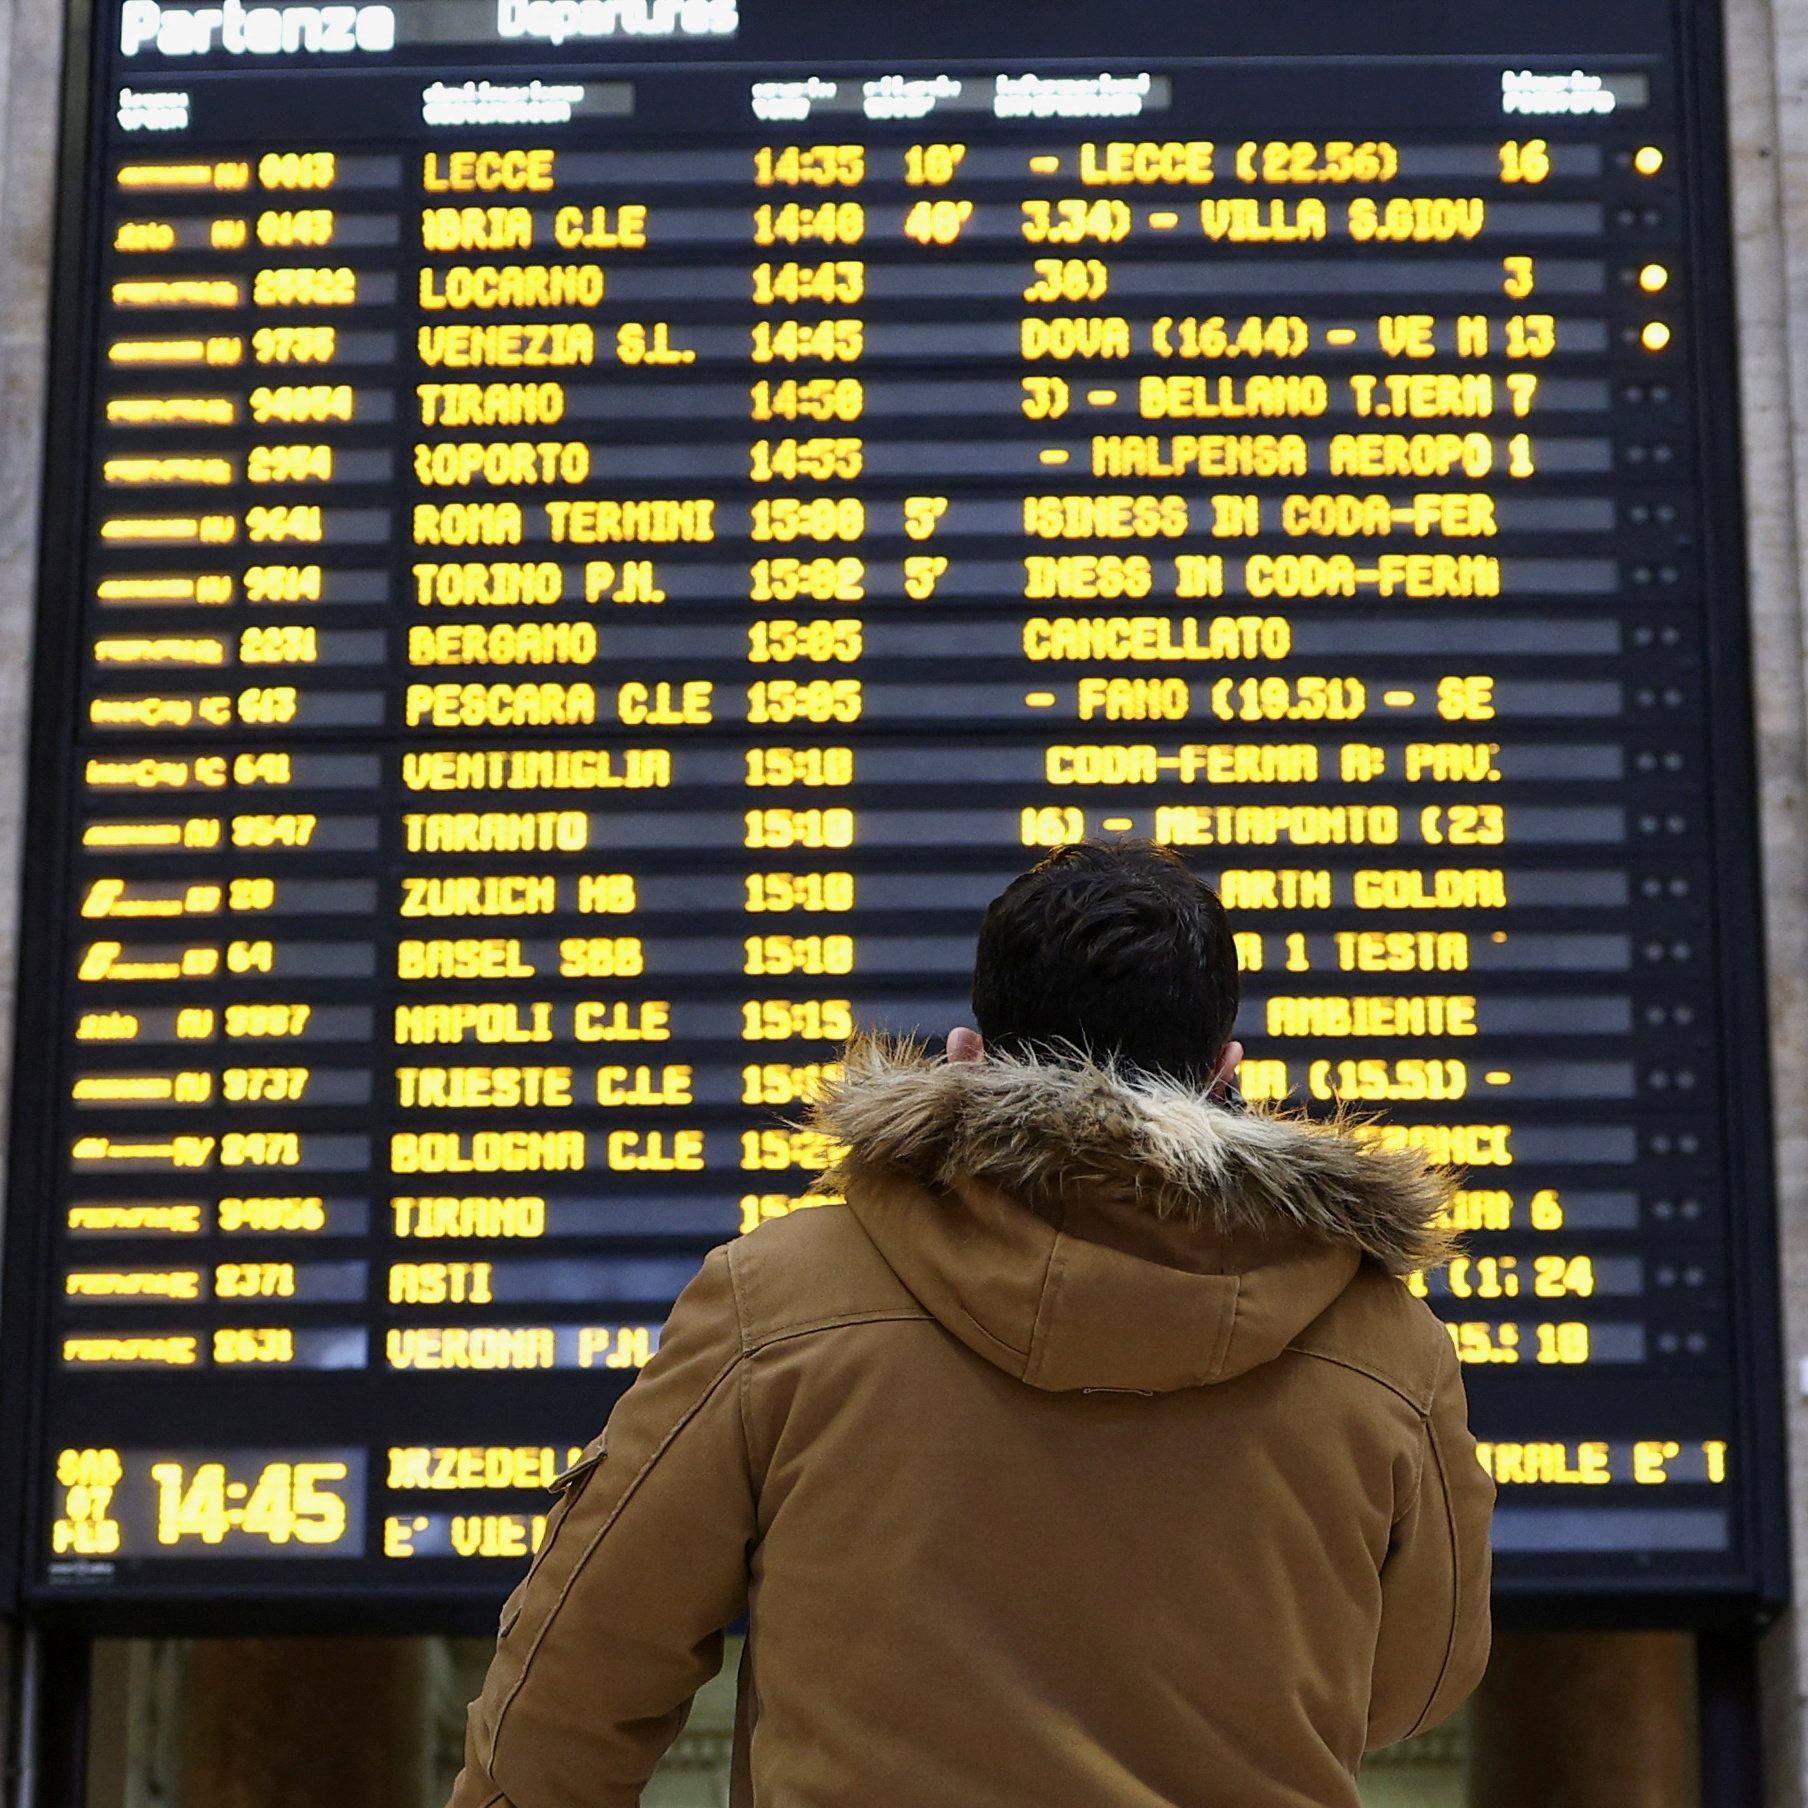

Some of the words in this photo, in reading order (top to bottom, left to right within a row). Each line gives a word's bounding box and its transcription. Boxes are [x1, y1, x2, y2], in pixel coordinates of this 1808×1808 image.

[424, 150, 554, 190] LECCE
[755, 146, 864, 184] 14:35
[1080, 142, 1213, 184] LECCE
[1237, 142, 1397, 181] (22.56)
[1499, 140, 1549, 182] 16
[754, 203, 864, 243] 14:40
[1201, 199, 1326, 240] VILLA
[1349, 198, 1484, 240] S.GIOV
[420, 265, 603, 308] LOCARNO
[753, 262, 864, 303] 14:43
[1504, 257, 1533, 297] 3
[418, 324, 593, 366] VENEZIA
[617, 323, 695, 363] S.L.
[752, 320, 863, 362] 14:45
[1021, 318, 1129, 359] DOVA
[1152, 317, 1308, 357] (16.44)
[1379, 316, 1435, 357] VE
[1506, 315, 1555, 357] 13
[417, 383, 563, 425] TIRANO
[751, 379, 863, 420] 14:50
[1140, 376, 1327, 418] BELLANO
[1351, 374, 1493, 417] T.TERM
[1507, 374, 1537, 416] 7
[751, 439, 862, 481] 14:55
[1093, 435, 1306, 476] MALPENSA
[1330, 433, 1493, 477] AEROPO
[1509, 434, 1534, 477] 1
[414, 503, 521, 544] ROMA
[546, 500, 714, 542] TERMINI
[751, 498, 864, 540] 15:00
[1212, 495, 1258, 536] IN
[1283, 494, 1497, 536] CODA-FER
[413, 563, 562, 605] TORINO
[751, 558, 864, 600] 15:02
[1175, 556, 1223, 597] IN
[409, 622, 596, 664] BERGAMO
[749, 620, 862, 662] 15:05
[1023, 617, 1290, 660] CANCELLATO
[407, 684, 595, 726] PESCARA
[748, 680, 861, 722] 15:05
[1079, 679, 1188, 720] FANO
[1437, 677, 1494, 719] SE
[403, 750, 670, 790] VENTIMIGLIA
[746, 748, 852, 785] 15:10
[1046, 745, 1318, 784] CODA-FERMA
[405, 812, 587, 852] TARANTO
[745, 809, 853, 847] 15:10
[1152, 806, 1398, 846] METAPONTO
[1421, 806, 1504, 844] (23
[401, 877, 555, 916] ZURICH
[579, 875, 635, 913] HB
[745, 873, 853, 911] 15:10
[1219, 870, 1330, 908] ARTH
[399, 940, 534, 978] BASEL
[560, 938, 643, 976] SBB
[744, 936, 853, 974] 15:10
[1286, 933, 1309, 971] 1
[1336, 933, 1468, 970] TESTA
[396, 1003, 552, 1044] NAPOLI
[742, 1000, 856, 1039] 15:15
[1267, 996, 1477, 1036] AMBIENTE
[398, 1068, 572, 1107] TRIESTE
[392, 1132, 584, 1172] BOLOGNA
[393, 1197, 545, 1237] TIRANO
[1532, 1191, 1562, 1230] 6
[389, 1263, 492, 1303] ASTI
[1535, 1256, 1593, 1296] 24
[387, 1328, 554, 1369] VERONA
[151, 1463, 347, 1544] 14:45
